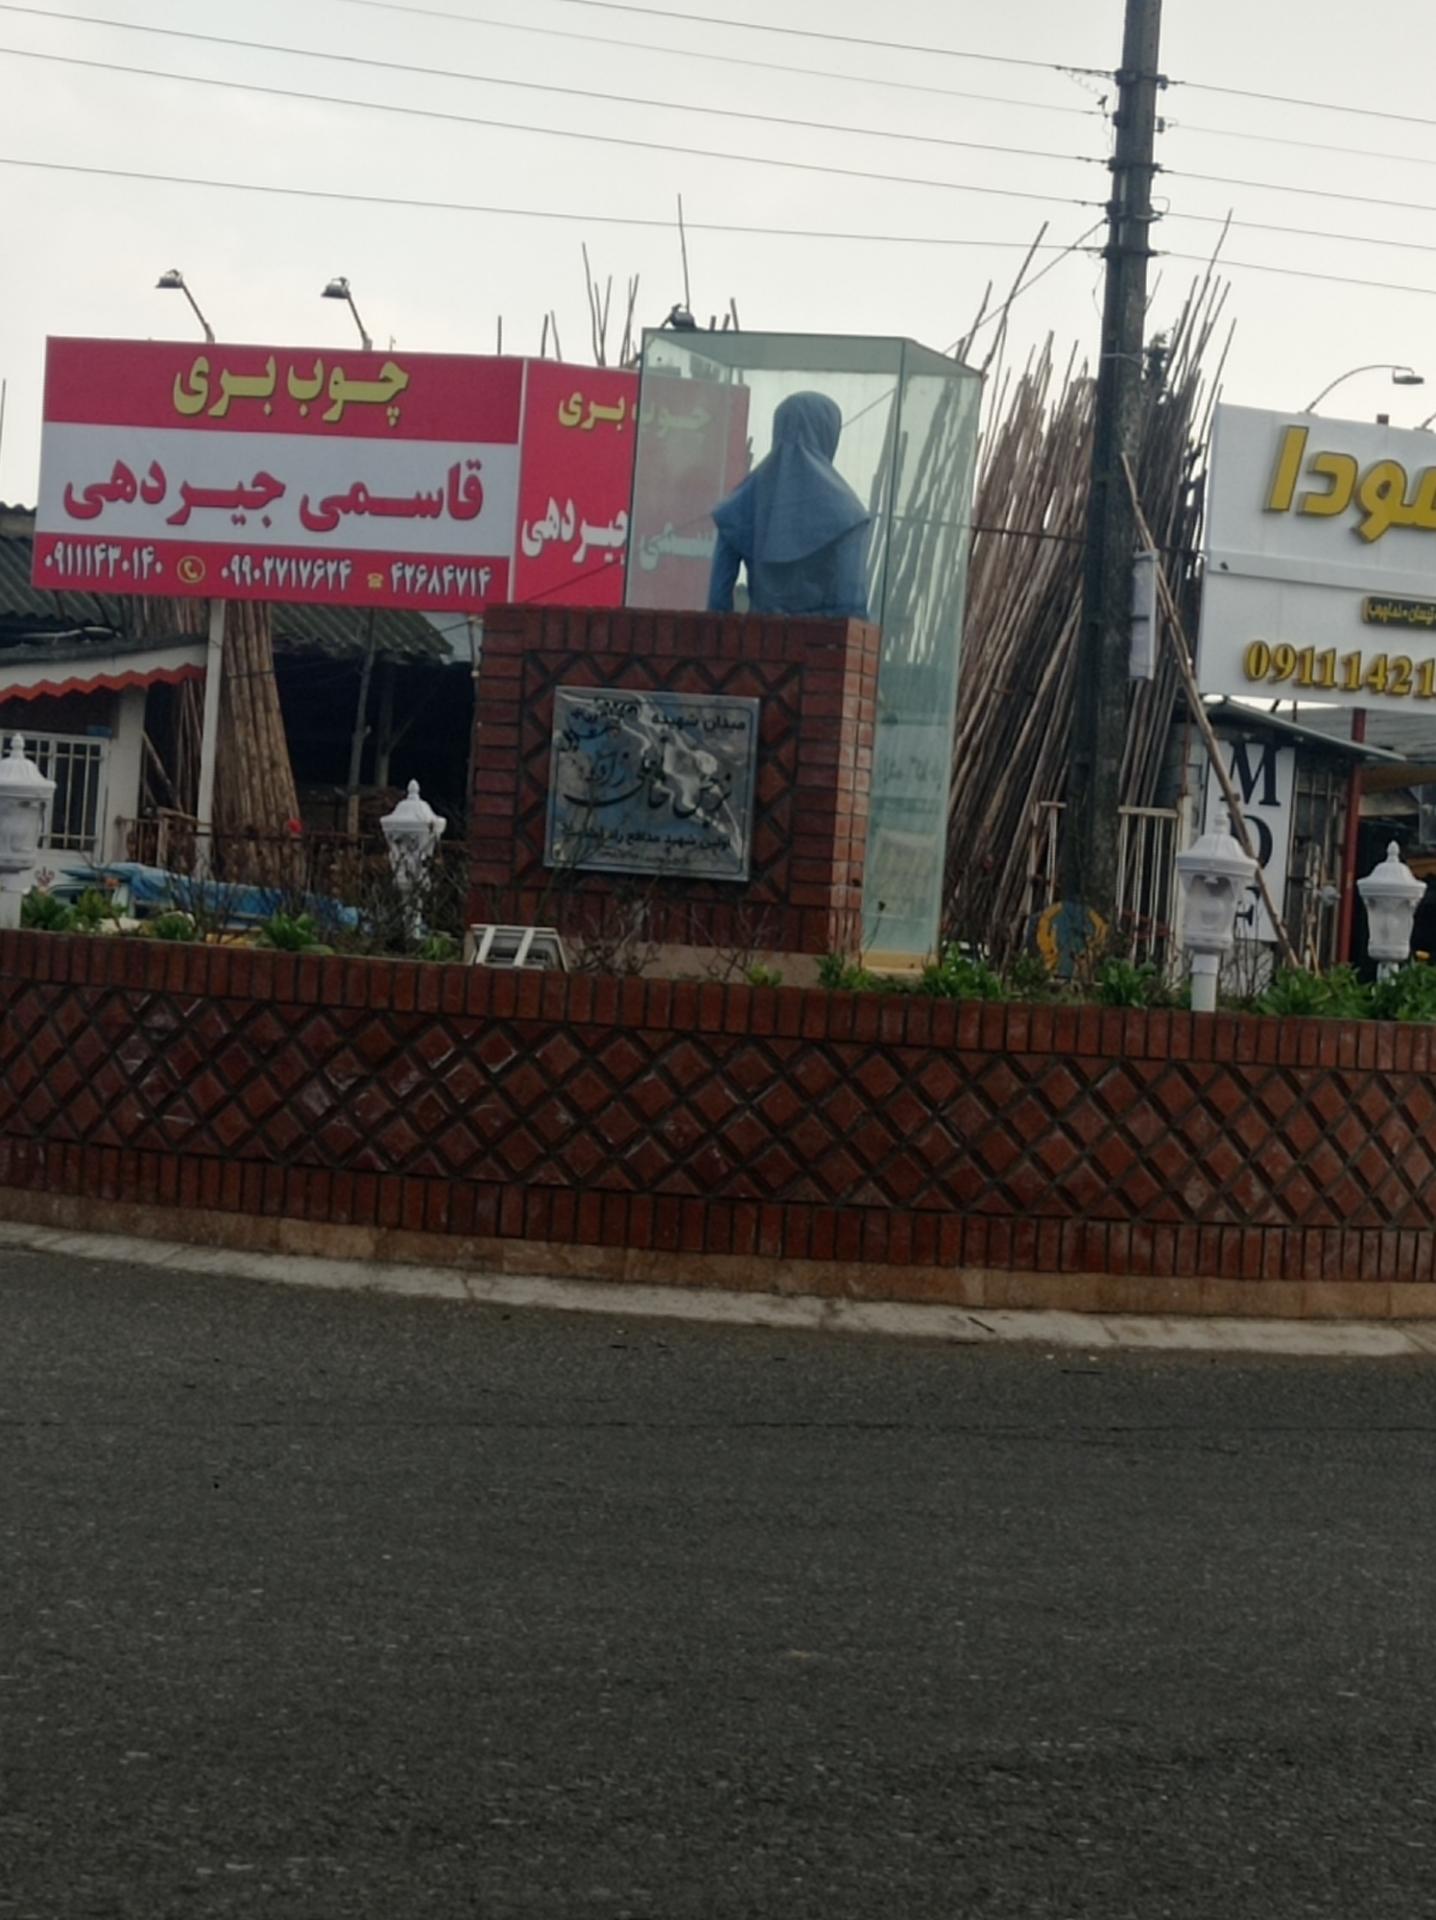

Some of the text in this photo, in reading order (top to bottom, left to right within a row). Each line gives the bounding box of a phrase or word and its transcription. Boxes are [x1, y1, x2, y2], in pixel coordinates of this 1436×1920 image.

[172, 355, 410, 425] چوب بری
[558, 391, 624, 431] بری
[62, 459, 485, 531] قاسمی جیردهی
[390, 561, 492, 598] ۴۲۶۸۴۷۱۴
[1243, 640, 1436, 701] 09111421
